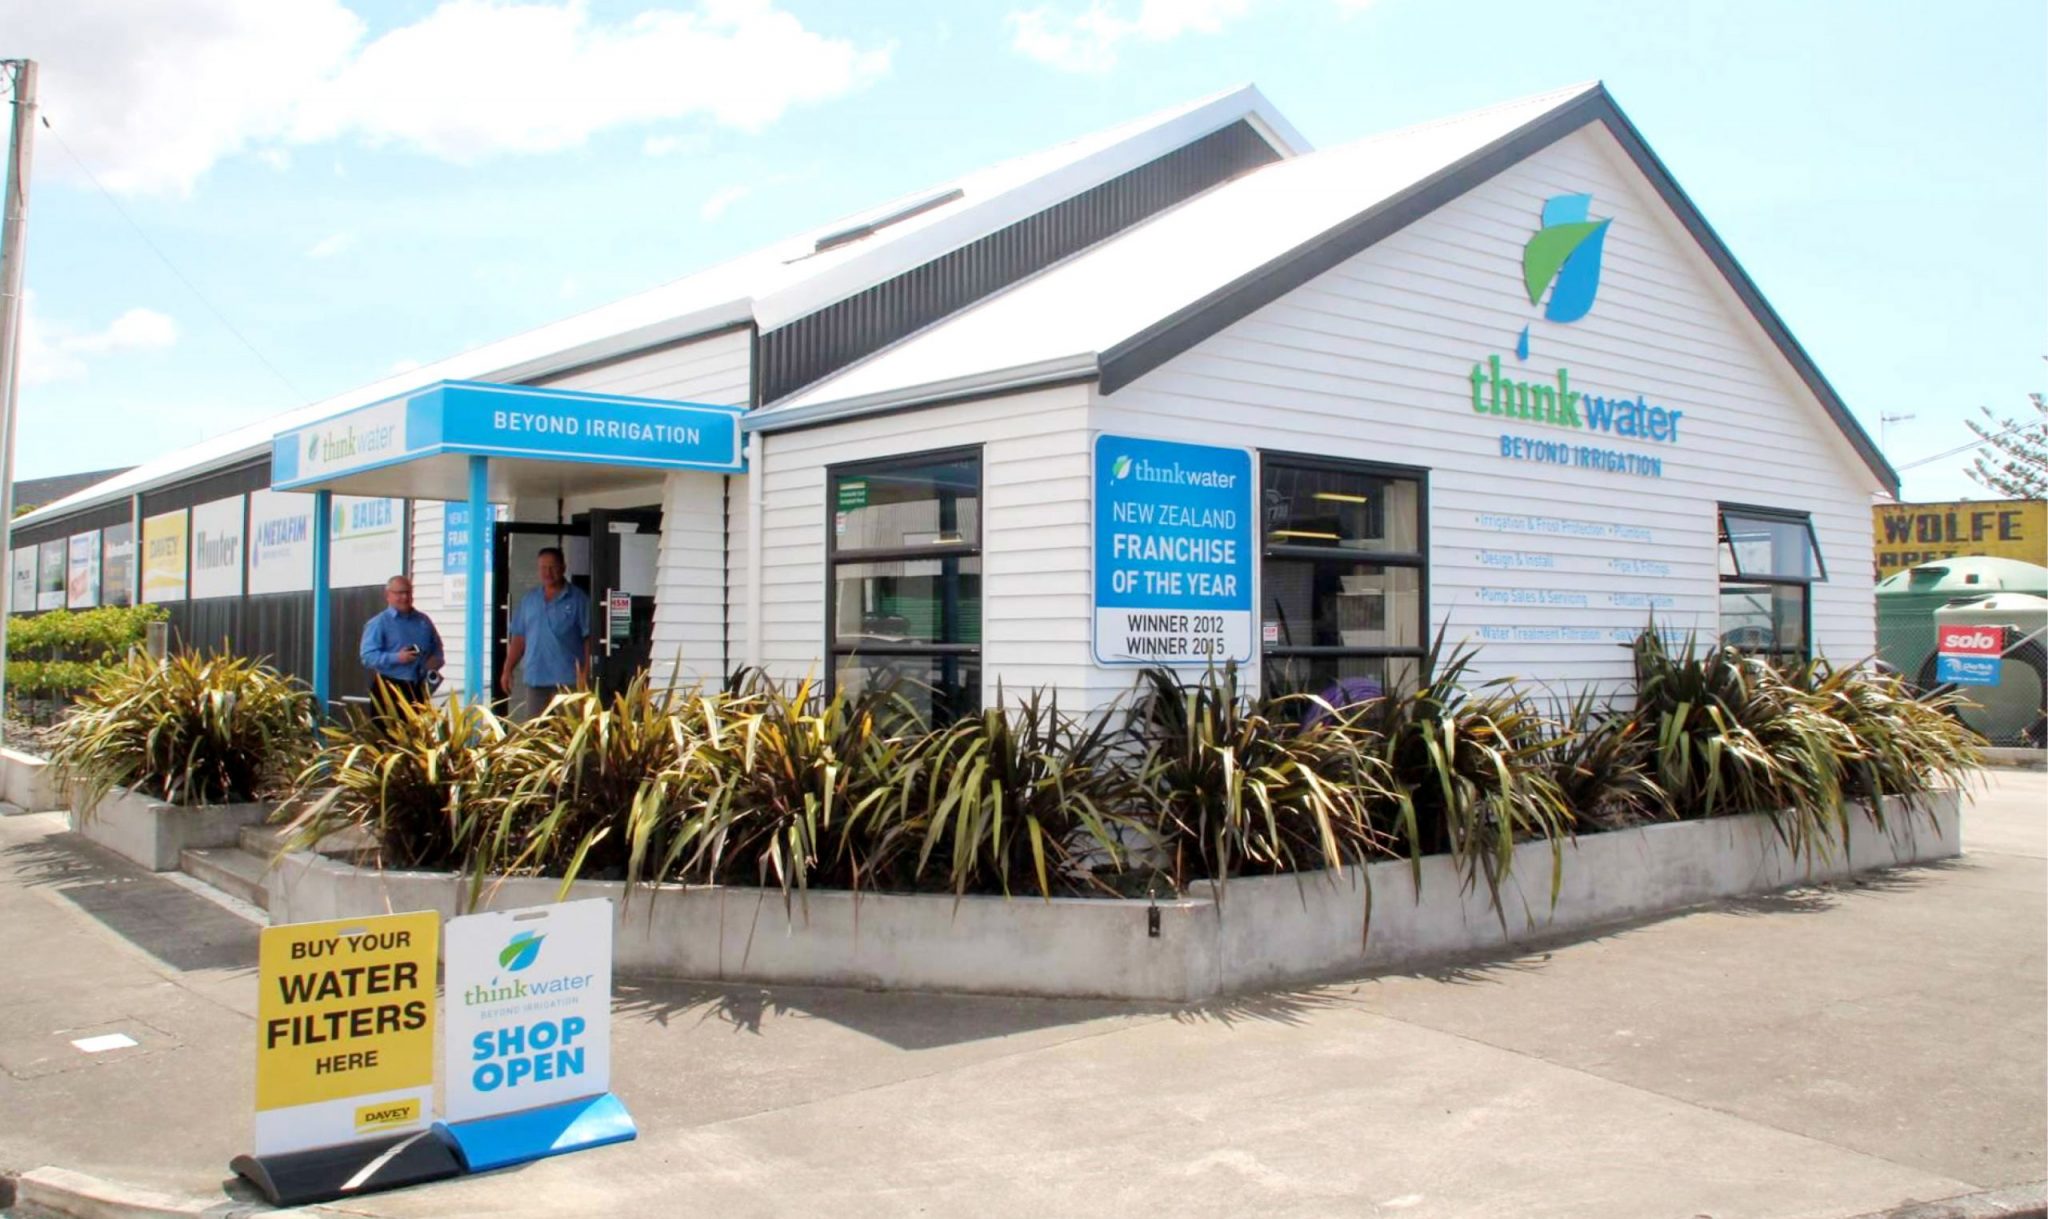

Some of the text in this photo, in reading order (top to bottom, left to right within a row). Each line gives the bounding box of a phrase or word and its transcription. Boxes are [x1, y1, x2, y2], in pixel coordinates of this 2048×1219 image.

[494, 411, 700, 445] BEYOND IRRIGATION
[1500, 435, 1662, 478] BEYOND IRRIGATION
[352, 498, 392, 529] BAUER
[1113, 501, 1154, 524] NEW
[1158, 504, 1237, 530] ZEALAND
[1480, 513, 1606, 536] Irrigation & Frost Protection
[1614, 525, 1652, 544] Plumbing
[197, 529, 238, 570] Hunter
[1113, 533, 1236, 565] FRANCHISE
[1481, 549, 1554, 569] Design & Install
[1112, 569, 1237, 597] OF THE YEAR
[1481, 587, 1588, 608] Pump Sales & Servicing
[1127, 614, 1224, 633] WINNER 2012
[1480, 626, 1509, 640] Water
[1511, 627, 1559, 640] Treatment
[1561, 628, 1602, 640] Filtration
[1126, 636, 1225, 655] WINNER 2015
[1944, 632, 1995, 650] solo
[291, 931, 411, 960] BUY YOUR
[278, 961, 419, 1005] WATER
[480, 996, 580, 1020] BEYOND IRRIGATION
[267, 1000, 427, 1049] FILTERS
[472, 1015, 586, 1061] SHOP
[315, 1050, 379, 1075] HERE
[472, 1046, 585, 1092] OPEN
[365, 1107, 411, 1123] DAVEY
